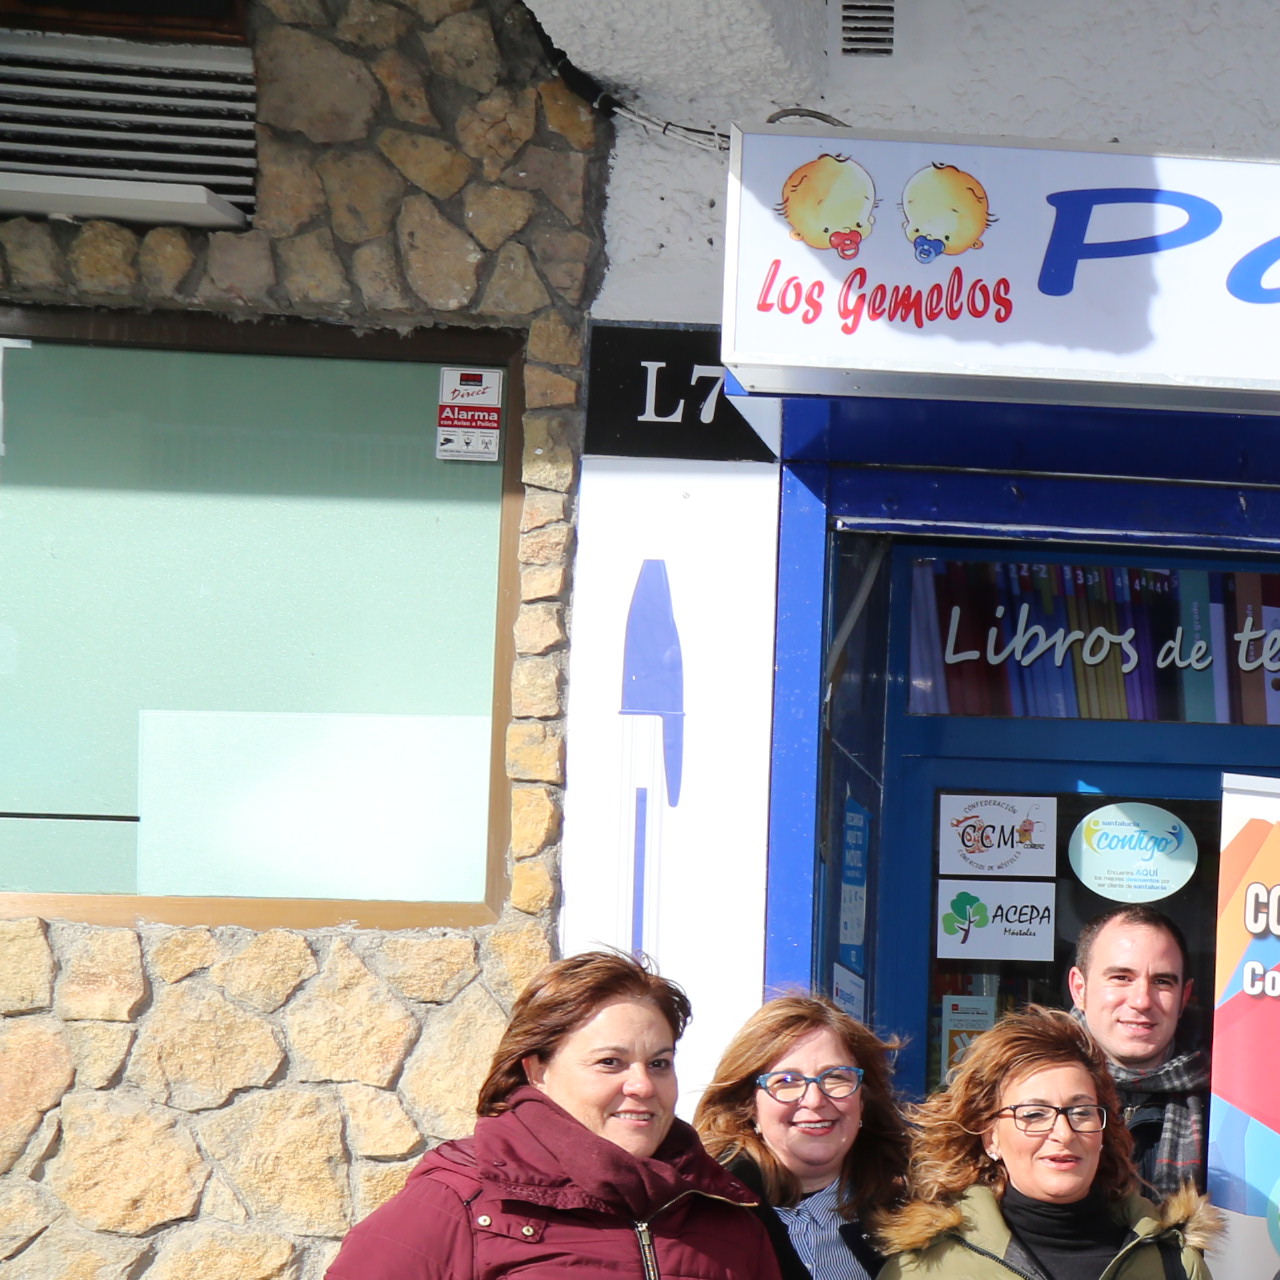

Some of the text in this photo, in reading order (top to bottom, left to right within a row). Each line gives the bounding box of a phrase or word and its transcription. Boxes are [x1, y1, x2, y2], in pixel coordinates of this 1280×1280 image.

[757, 259, 1014, 335] Los Gemelos
[441, 407, 498, 420] Alarma
[945, 603, 1139, 674] Libros
[1157, 626, 1213, 670] de
[963, 799, 1018, 815] CONFEDERACIÓN
[961, 824, 1016, 849] CCM
[991, 904, 1051, 925] ACEPA
[1003, 927, 1036, 937] Móstoles
